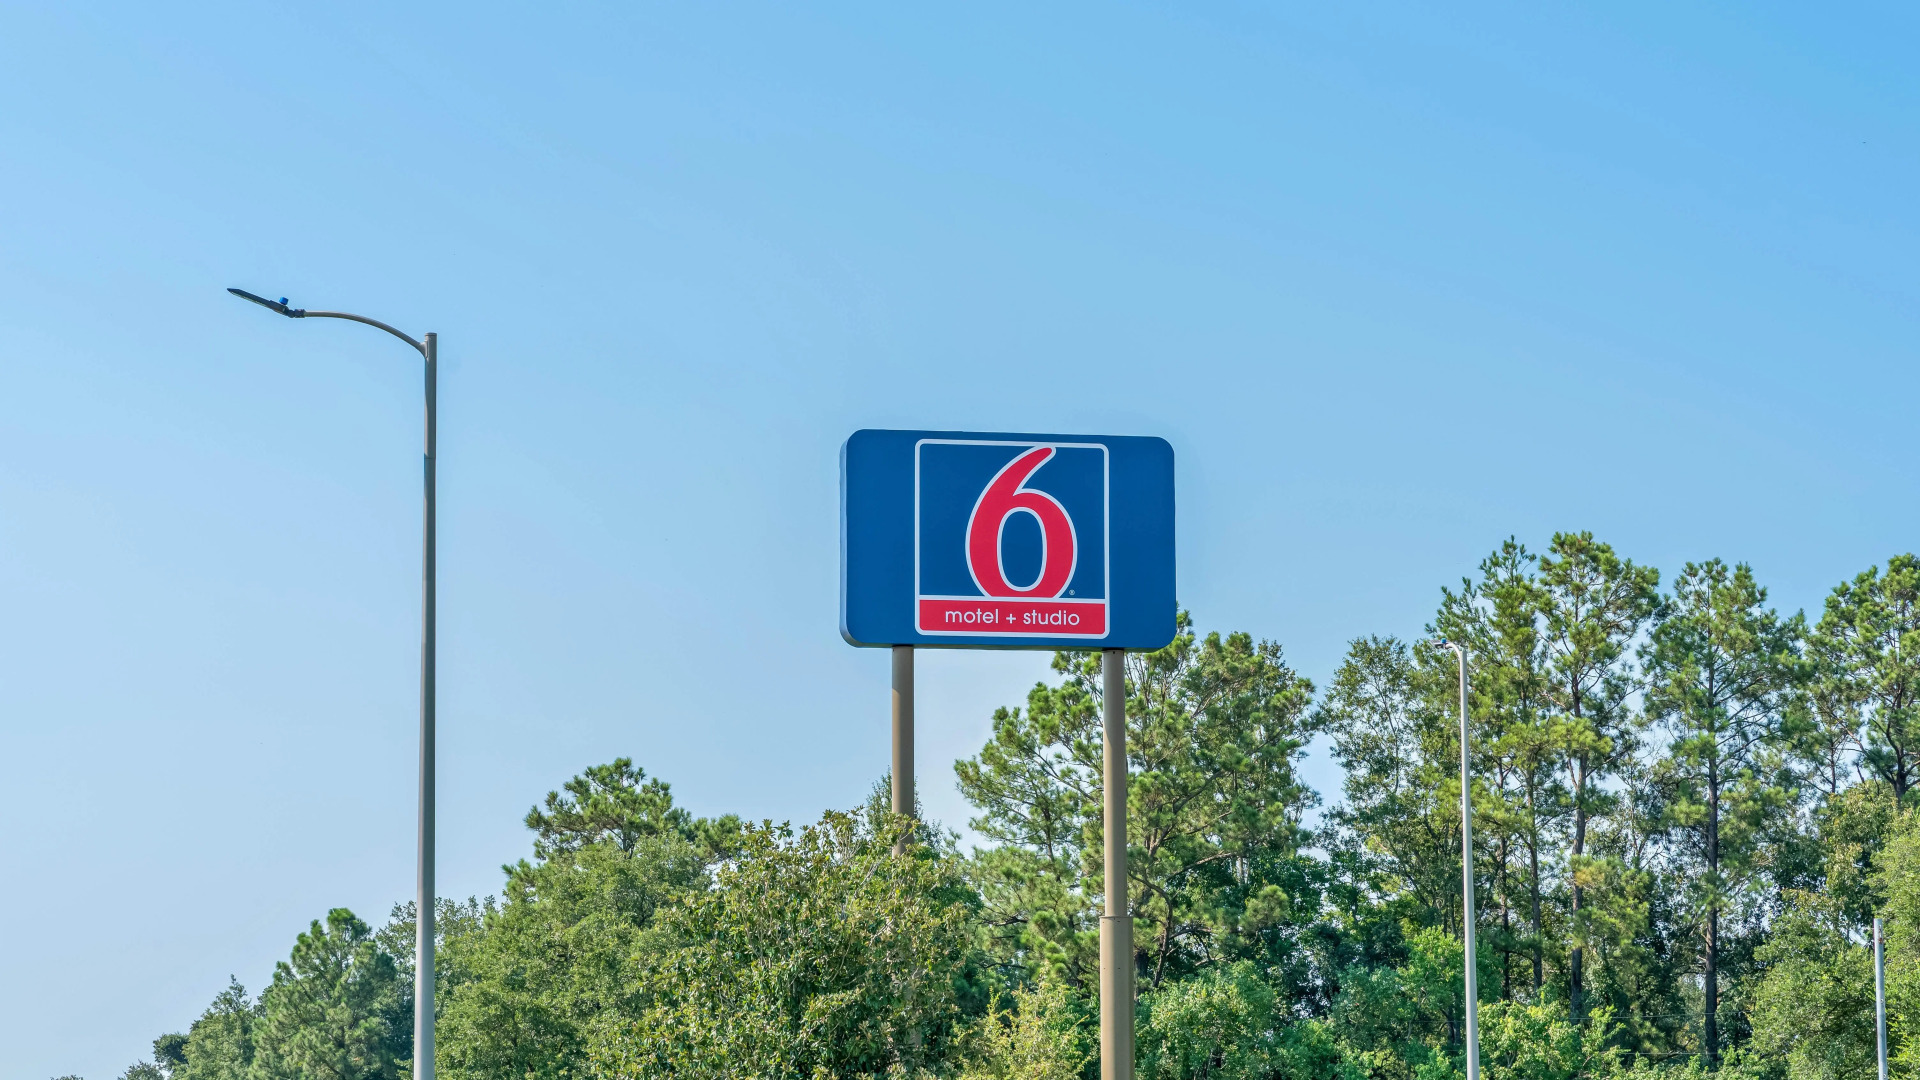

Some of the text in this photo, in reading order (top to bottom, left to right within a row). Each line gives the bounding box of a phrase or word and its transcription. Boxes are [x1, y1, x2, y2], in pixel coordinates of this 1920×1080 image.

[965, 445, 1078, 598] 6
[945, 608, 999, 624] motel
[1023, 609, 1080, 626] studio
